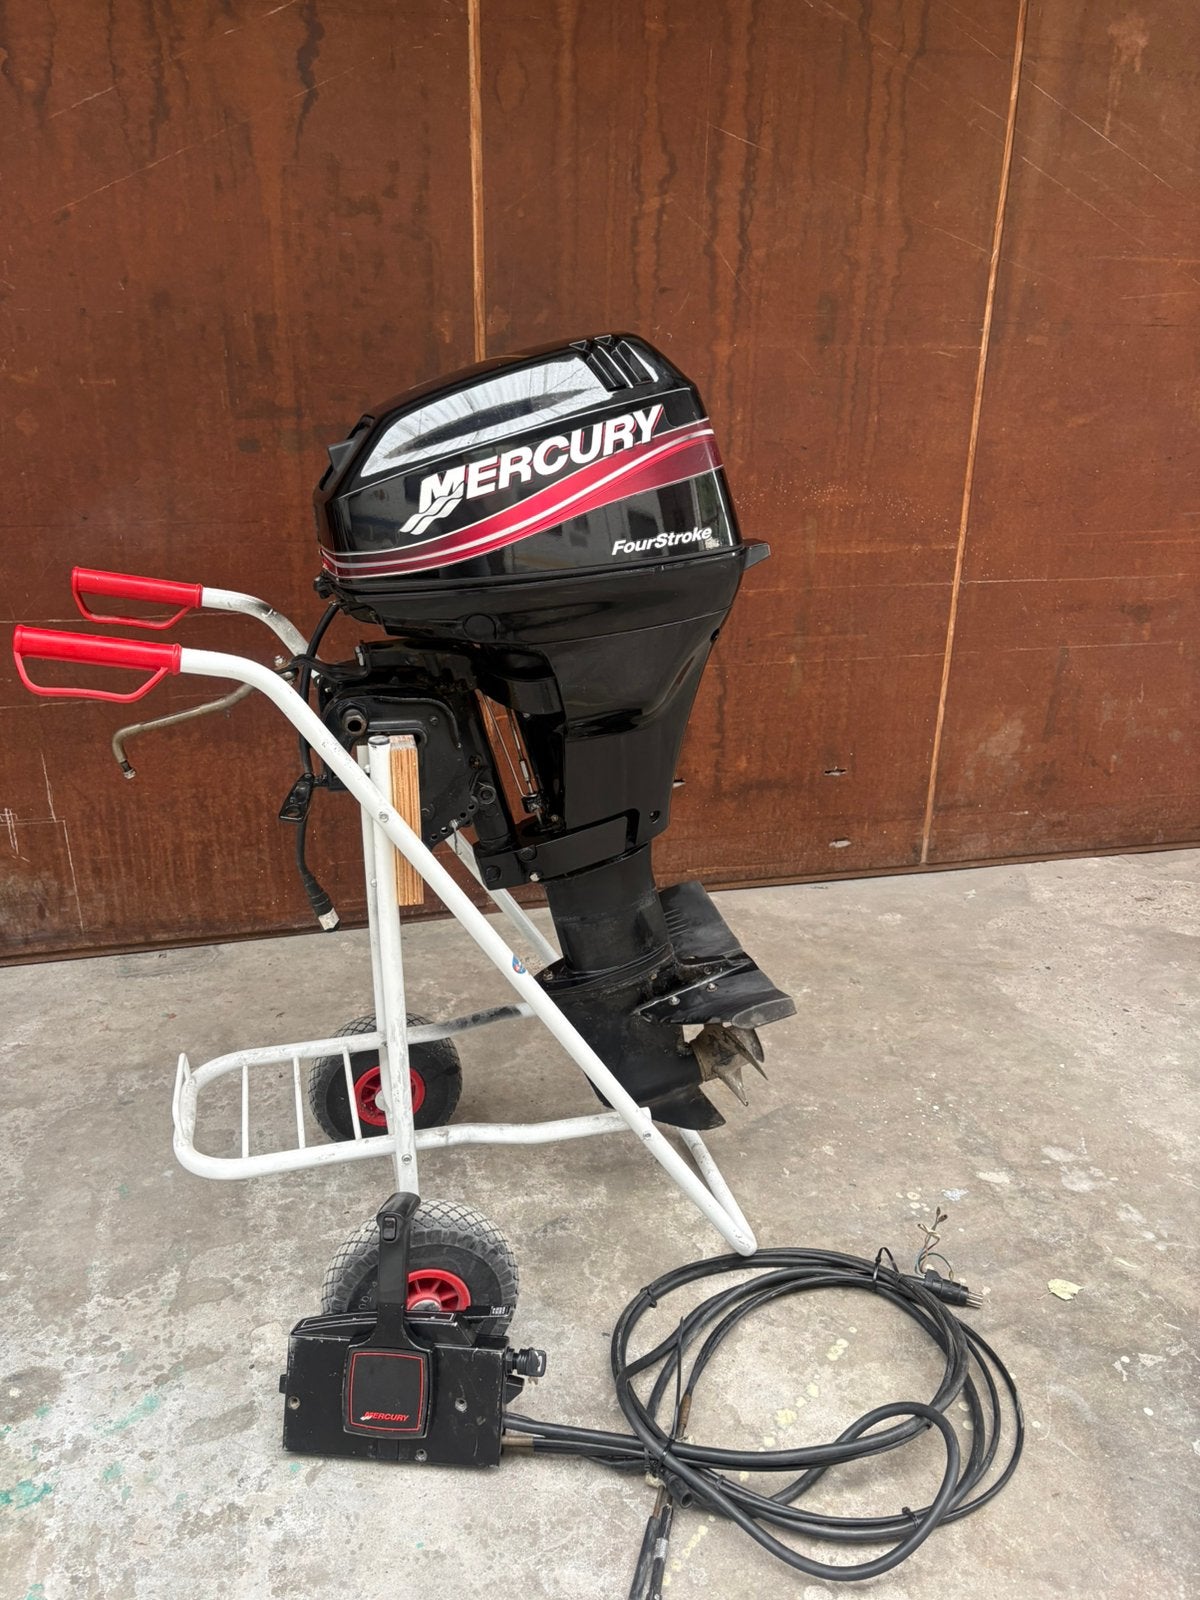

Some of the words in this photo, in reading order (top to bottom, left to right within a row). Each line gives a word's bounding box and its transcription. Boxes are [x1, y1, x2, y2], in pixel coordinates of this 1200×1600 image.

[400, 403, 664, 535] MERCURY
[611, 526, 713, 556] FourStroke
[361, 1411, 409, 1421] MERCURY
